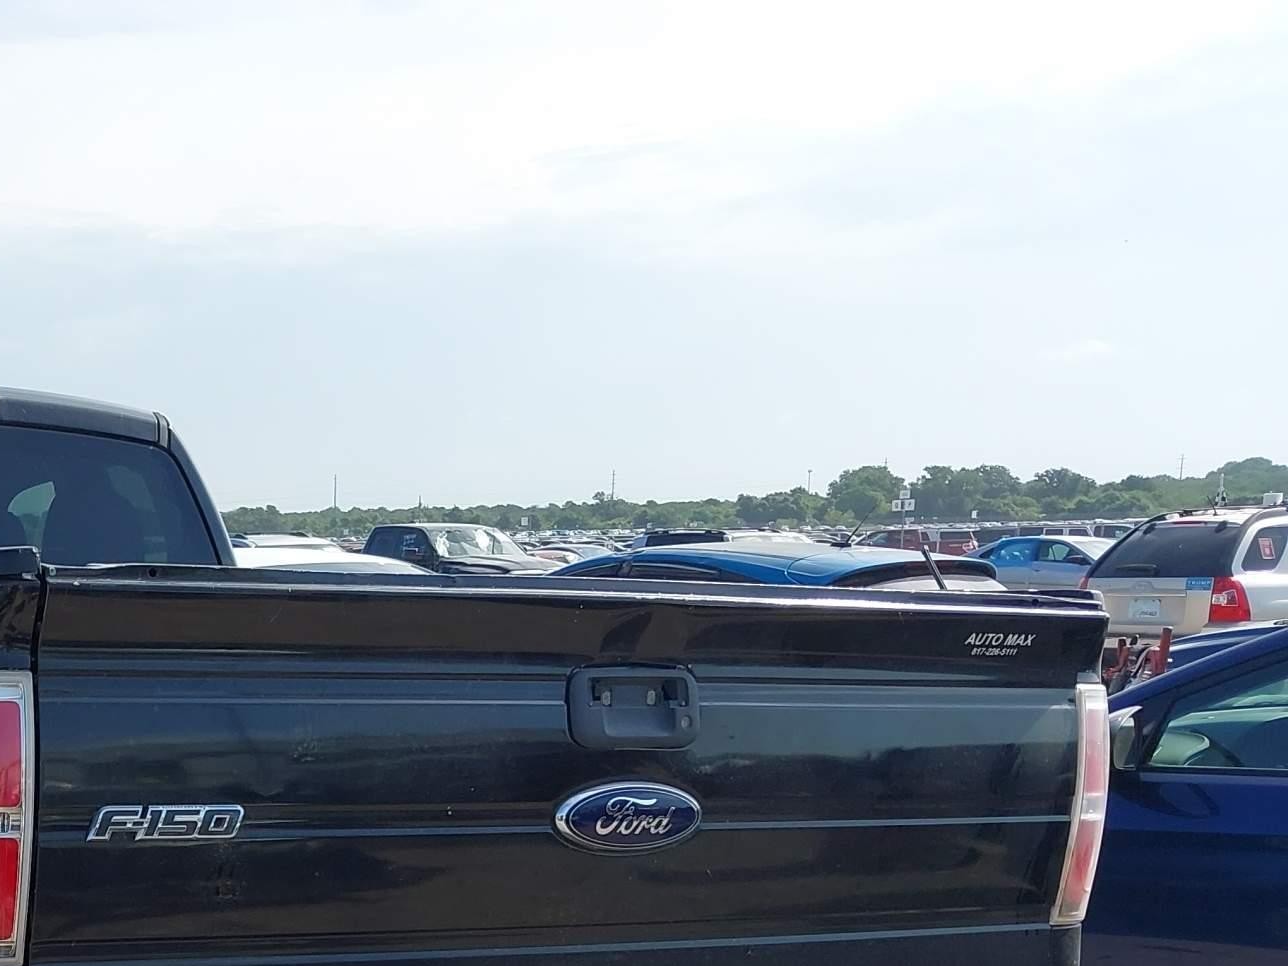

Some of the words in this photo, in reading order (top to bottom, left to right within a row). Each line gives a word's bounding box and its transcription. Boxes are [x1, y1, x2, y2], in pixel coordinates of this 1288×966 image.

[964, 632, 1004, 646] AUTO
[1004, 633, 1037, 647] MAX
[86, 804, 245, 841] F-150
[596, 796, 676, 835] Ford
